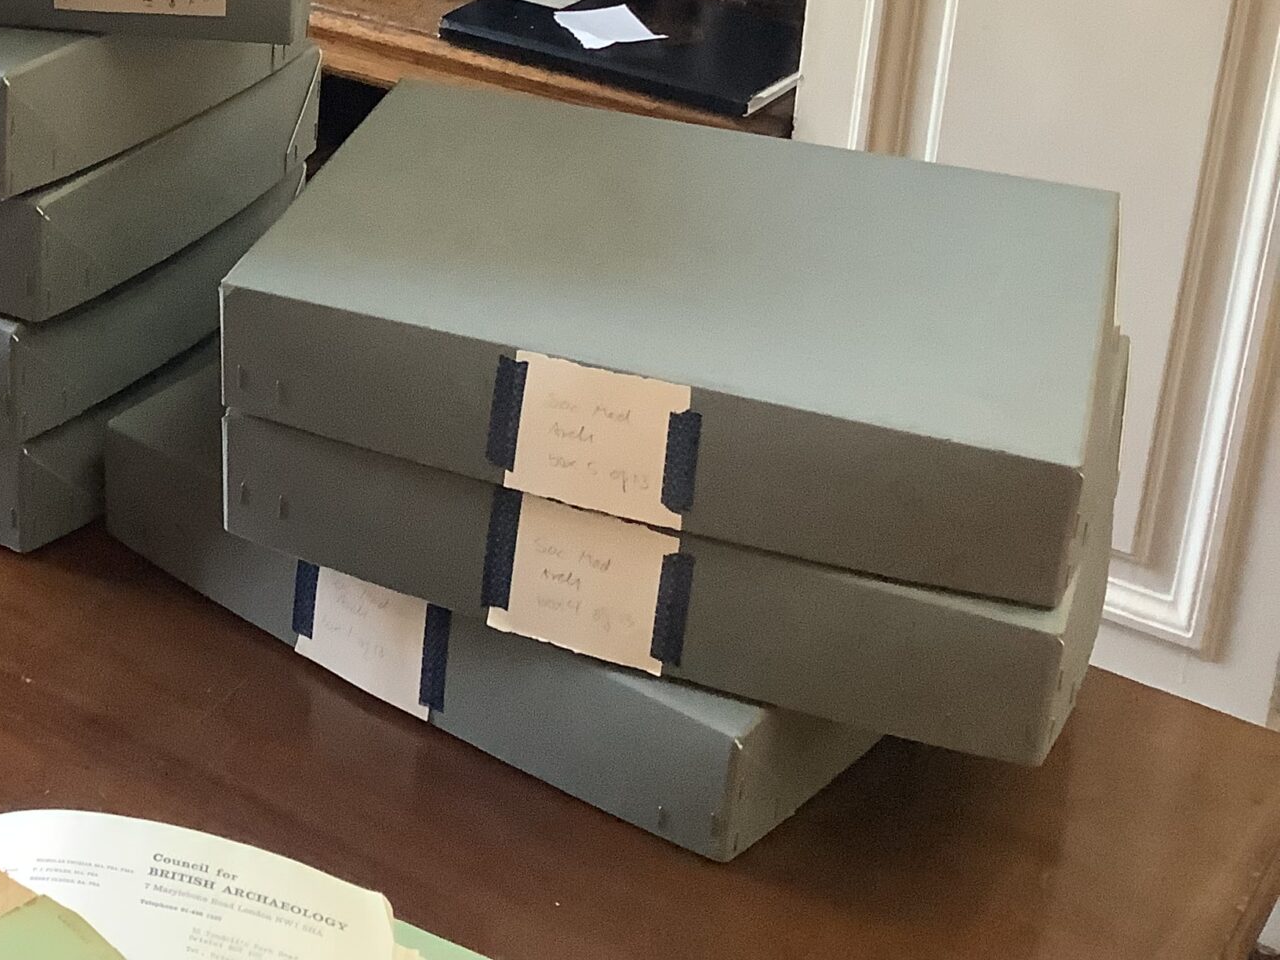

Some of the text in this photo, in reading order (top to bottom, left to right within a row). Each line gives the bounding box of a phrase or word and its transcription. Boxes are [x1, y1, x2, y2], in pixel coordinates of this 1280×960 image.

[591, 405, 631, 422] Med
[578, 550, 612, 572] Med
[152, 853, 210, 873] Council
[216, 868, 238, 881] for
[148, 867, 216, 890] BRITISH
[222, 885, 349, 931] ARCHAEOLOGY
[238, 904, 272, 921] London
